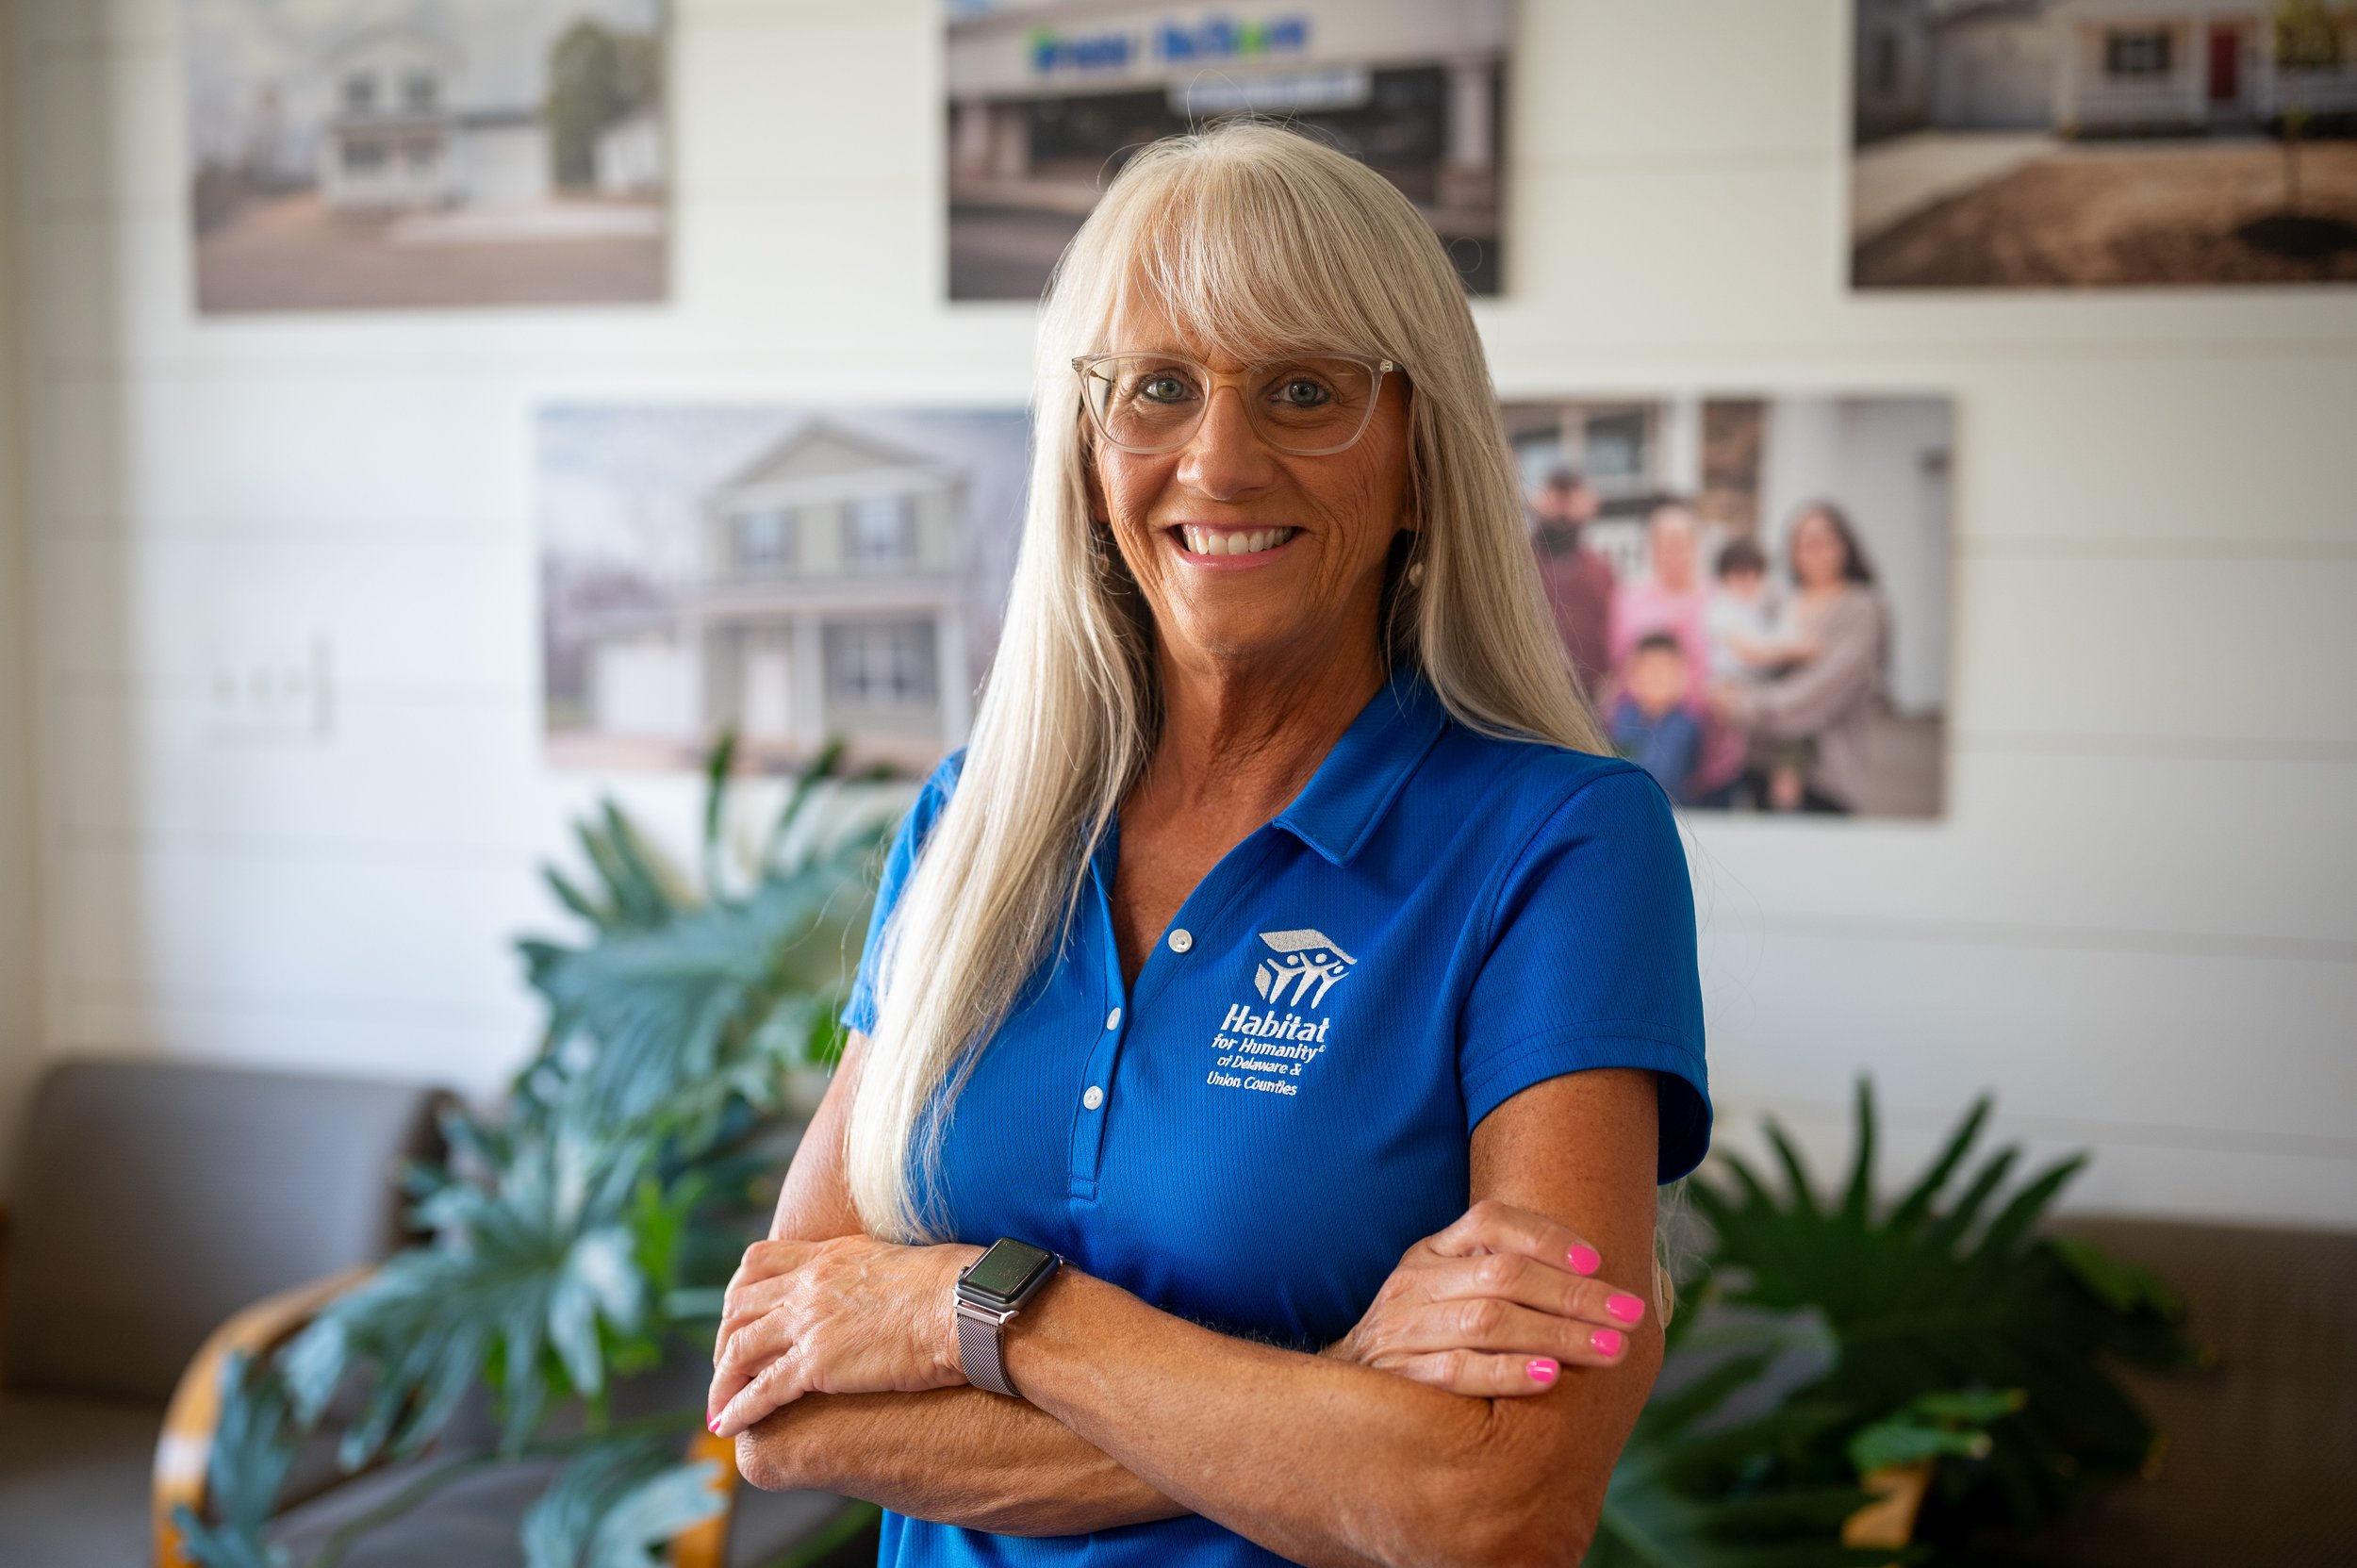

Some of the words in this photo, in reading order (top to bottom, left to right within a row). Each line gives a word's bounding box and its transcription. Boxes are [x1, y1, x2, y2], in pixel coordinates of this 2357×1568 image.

[1221, 1003, 1330, 1043] Habitat
[1211, 1033, 1238, 1050] for
[1217, 1055, 1232, 1067] of
[1231, 1055, 1289, 1074] Delaware
[1290, 1063, 1302, 1077] &
[1207, 1070, 1242, 1088] Union
[1244, 1076, 1298, 1097] Counties
